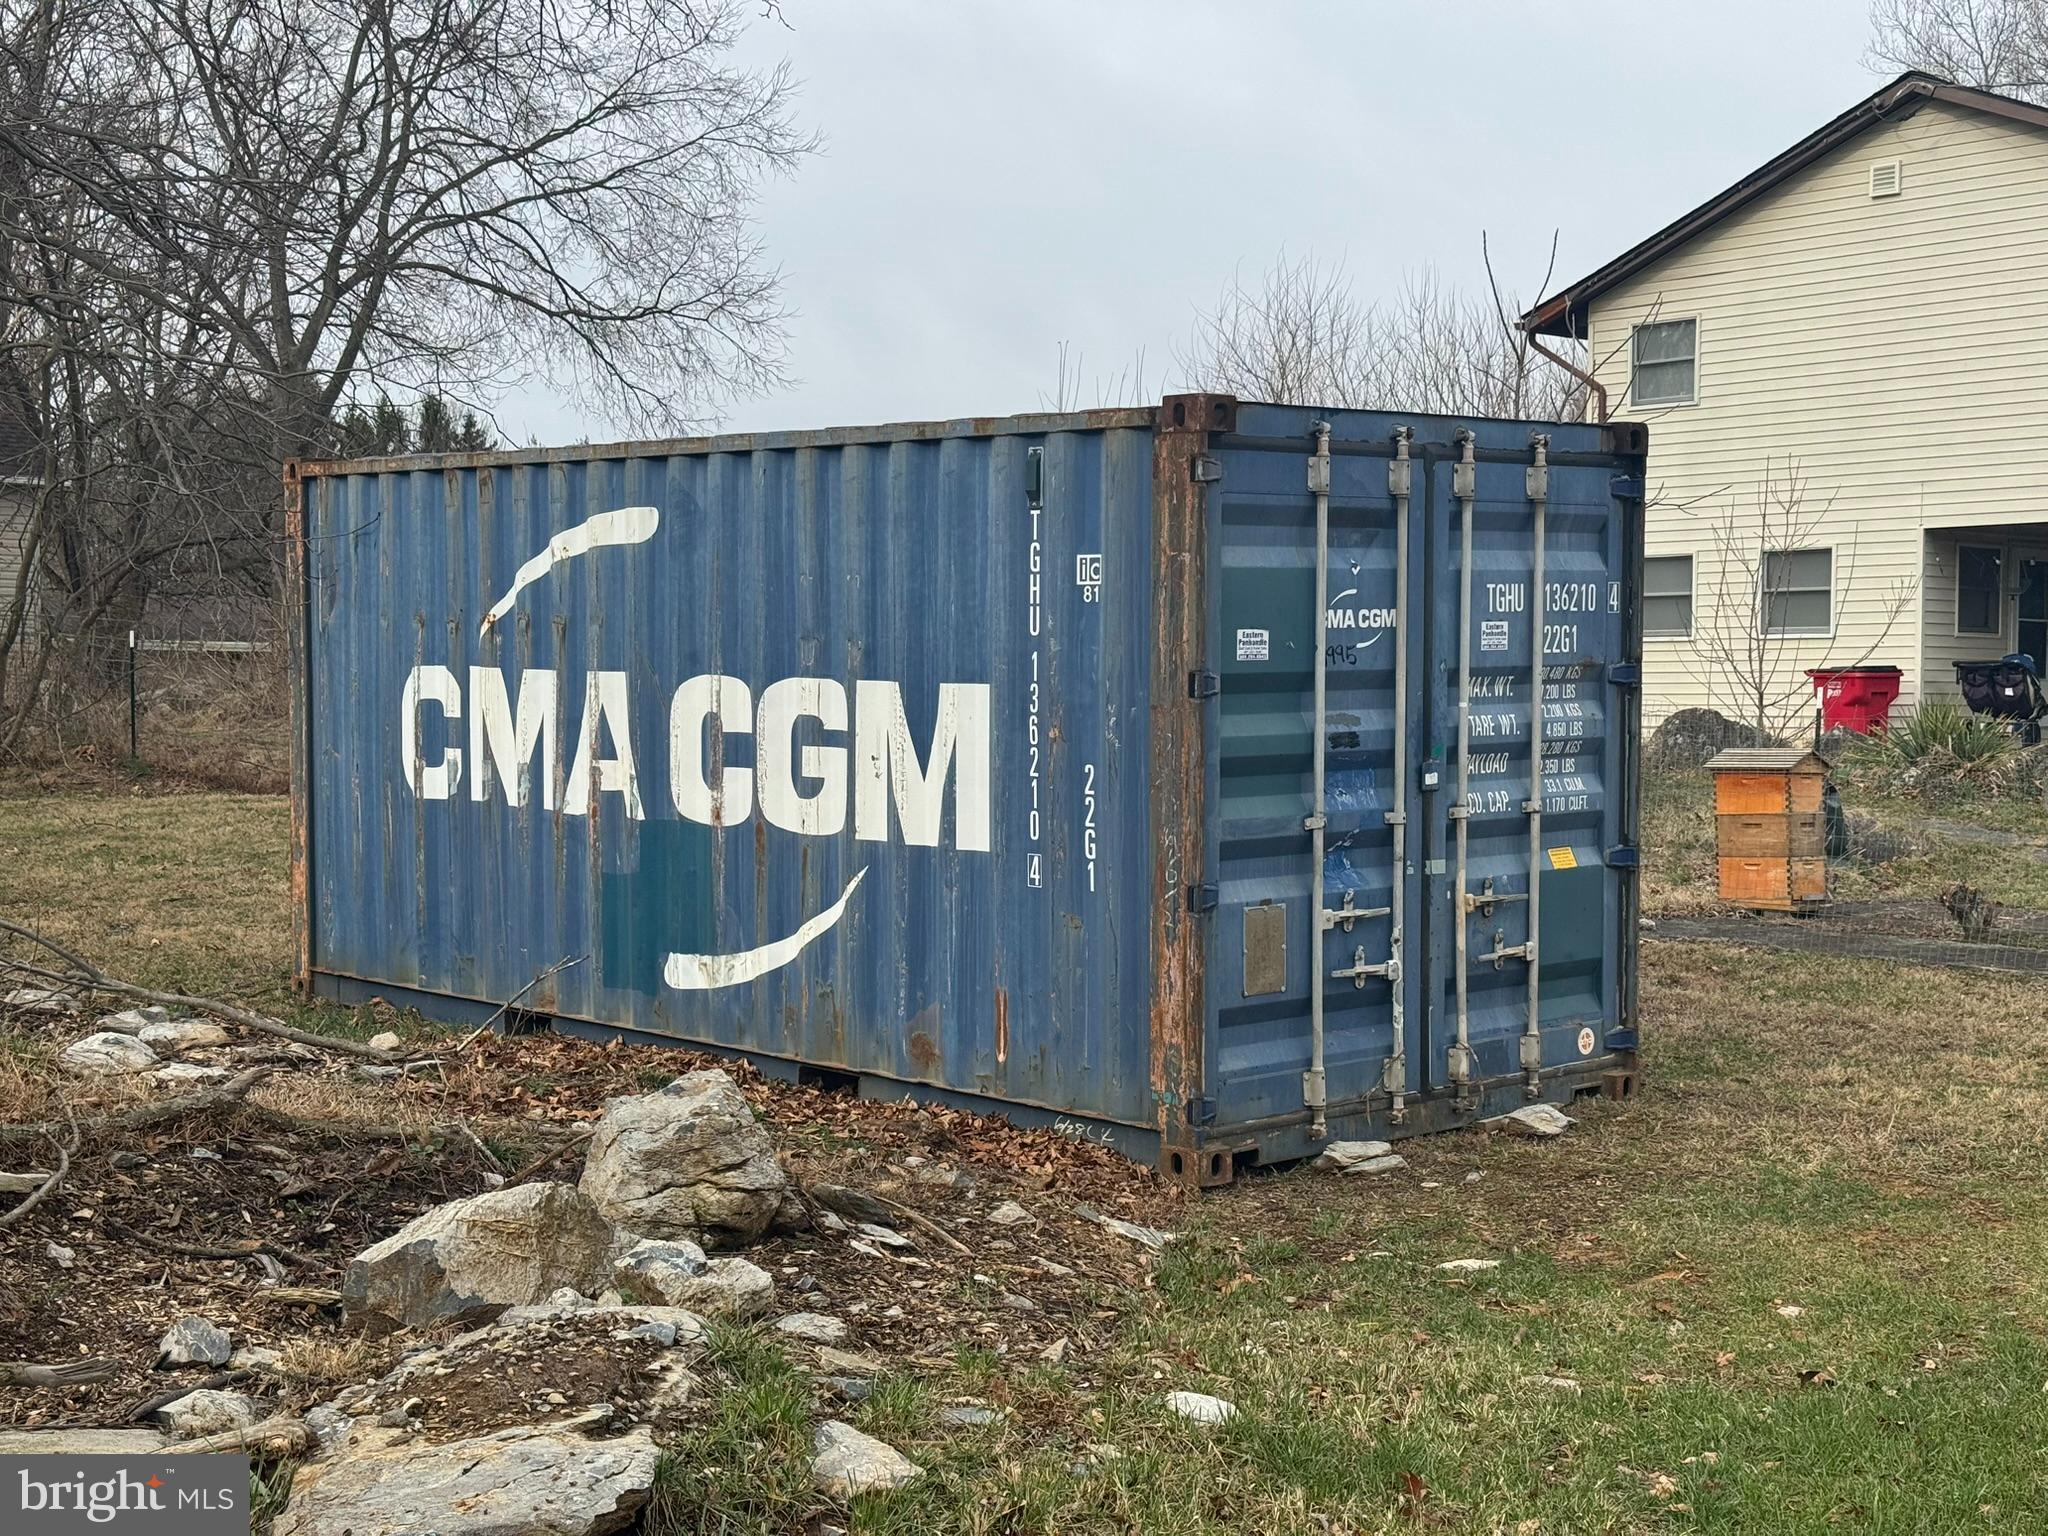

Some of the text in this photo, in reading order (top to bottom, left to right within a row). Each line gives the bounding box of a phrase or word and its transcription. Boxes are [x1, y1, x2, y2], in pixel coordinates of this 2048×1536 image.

[1083, 585, 1099, 603] 81
[1486, 583, 1619, 612] TGHU 136210 4
[1325, 608, 1397, 629] MA CGM
[1242, 631, 1264, 639] Eastern
[1544, 624, 1577, 653] 22G1
[1565, 666, 1583, 680] KGS
[1494, 675, 1514, 697] WT.
[1562, 684, 1576, 699] LBS
[1028, 510, 1041, 886] TGHU 136210 4
[1564, 703, 1583, 717] KGS
[1467, 714, 1520, 736] TARE WT.
[1546, 721, 1583, 737] 4.850 LBS
[1564, 740, 1583, 754] KGS
[402, 665, 991, 852] CMA CGM
[1561, 758, 1576, 773] LBS
[1544, 778, 1563, 793] 33.1
[1467, 790, 1511, 814] CU. CAP.
[1546, 797, 1566, 813] 1.170
[1083, 764, 1096, 892] 22G1
